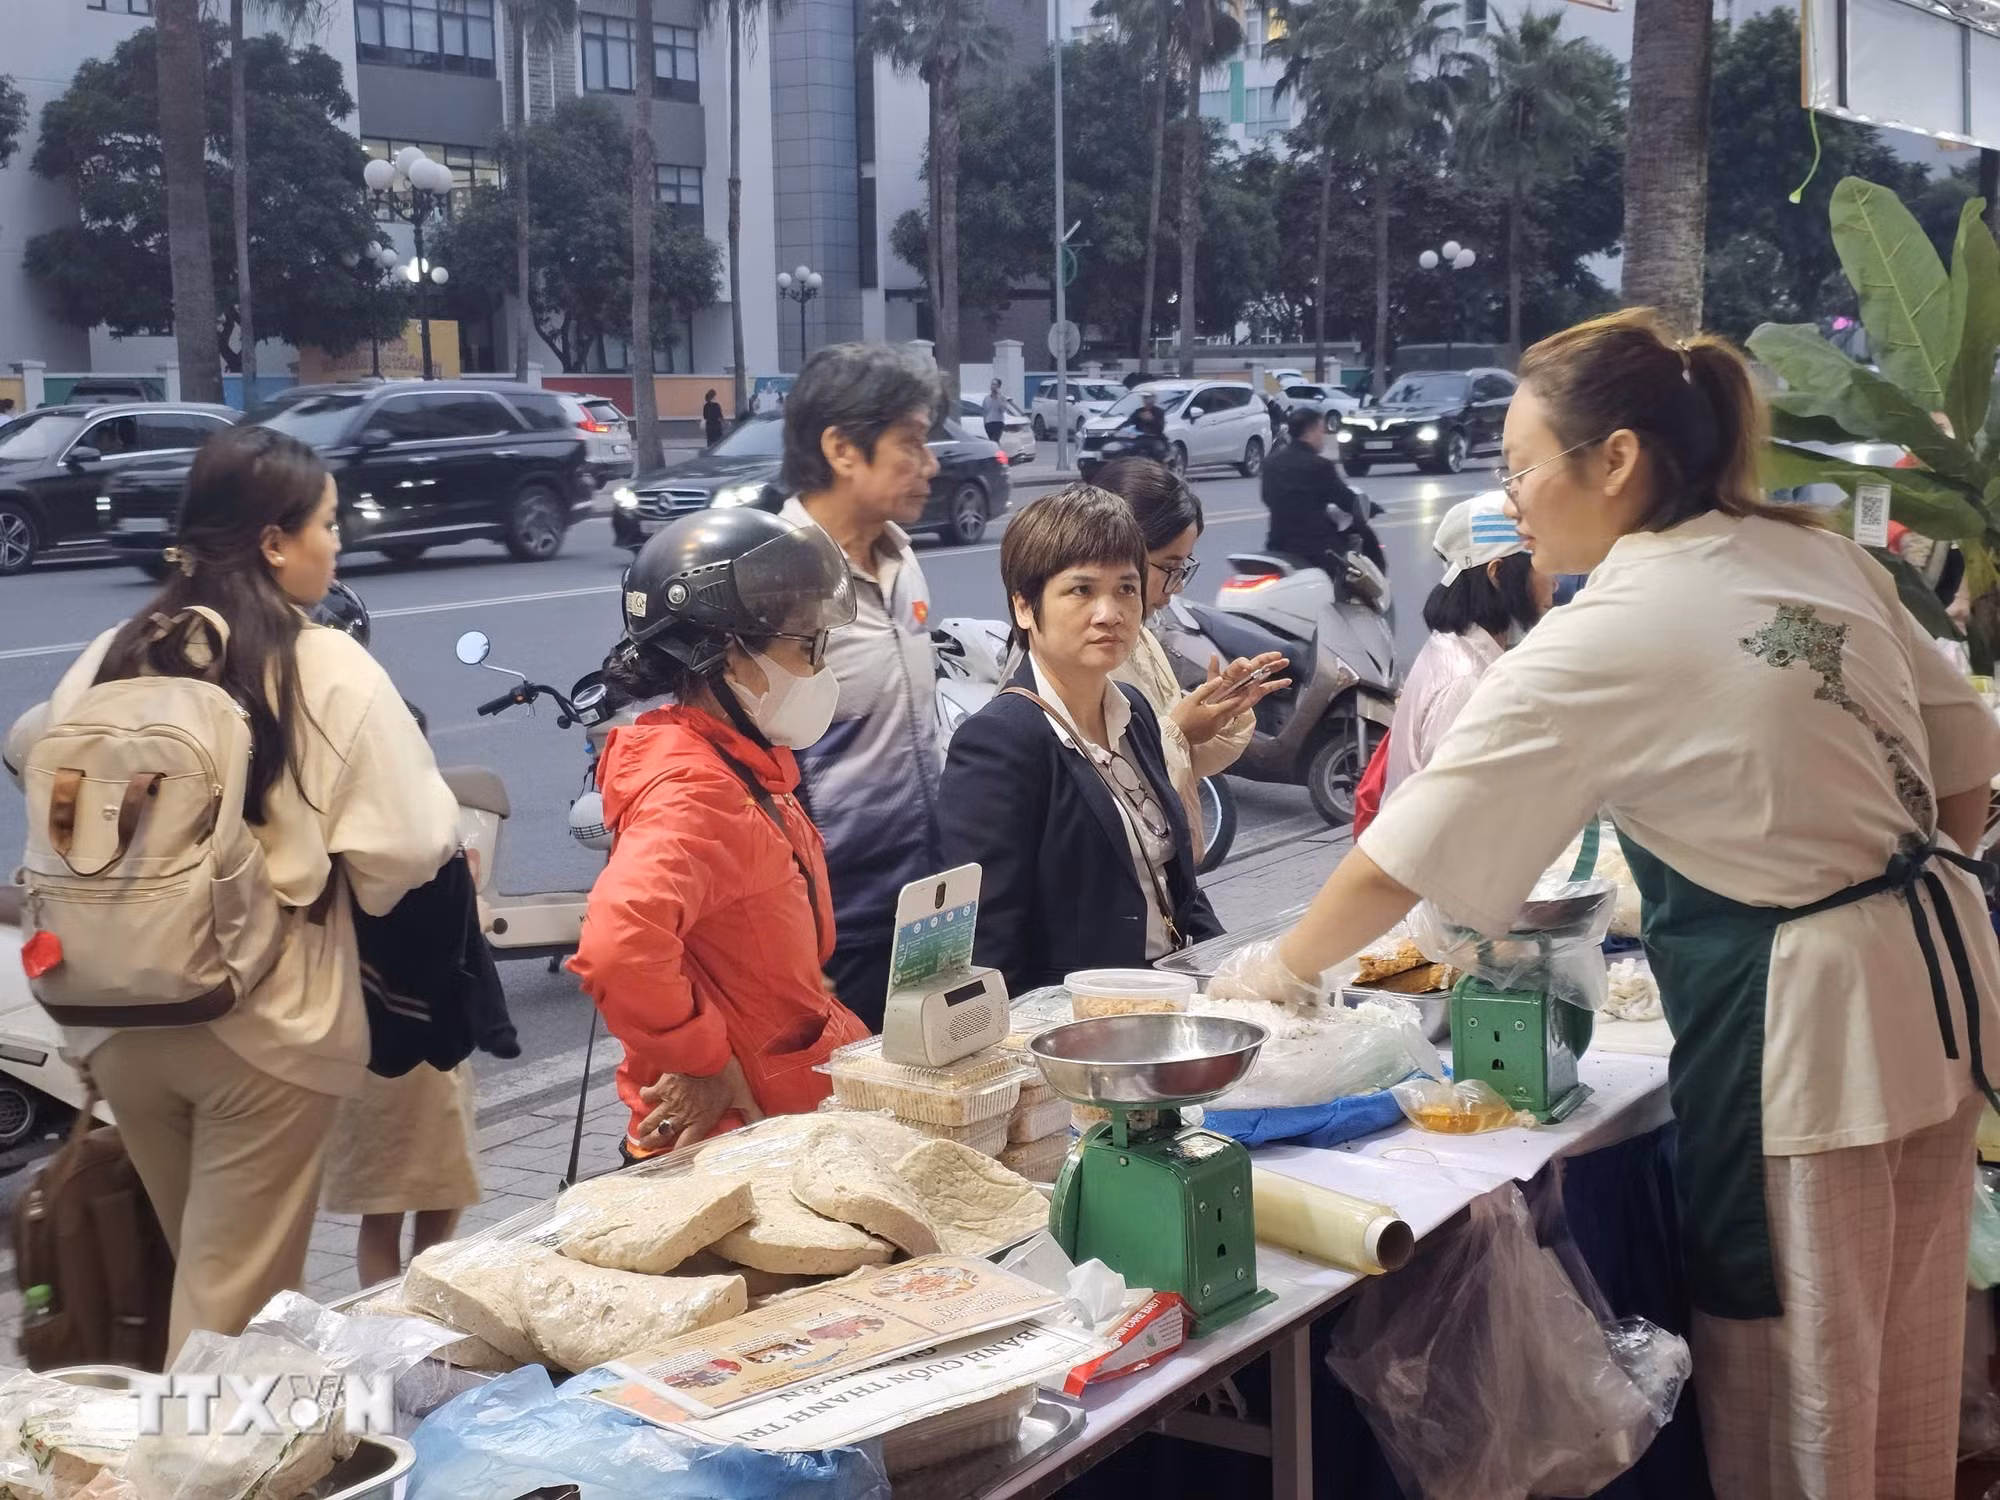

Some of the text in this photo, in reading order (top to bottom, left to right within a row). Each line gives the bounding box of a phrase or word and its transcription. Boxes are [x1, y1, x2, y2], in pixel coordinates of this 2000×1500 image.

[1123, 1311, 1146, 1329] CARE
[1141, 1298, 1162, 1315] BABY
[963, 1329, 1043, 1365] BÁNH
[888, 1359, 965, 1385] CUỐN
[784, 1379, 891, 1424] THANH
